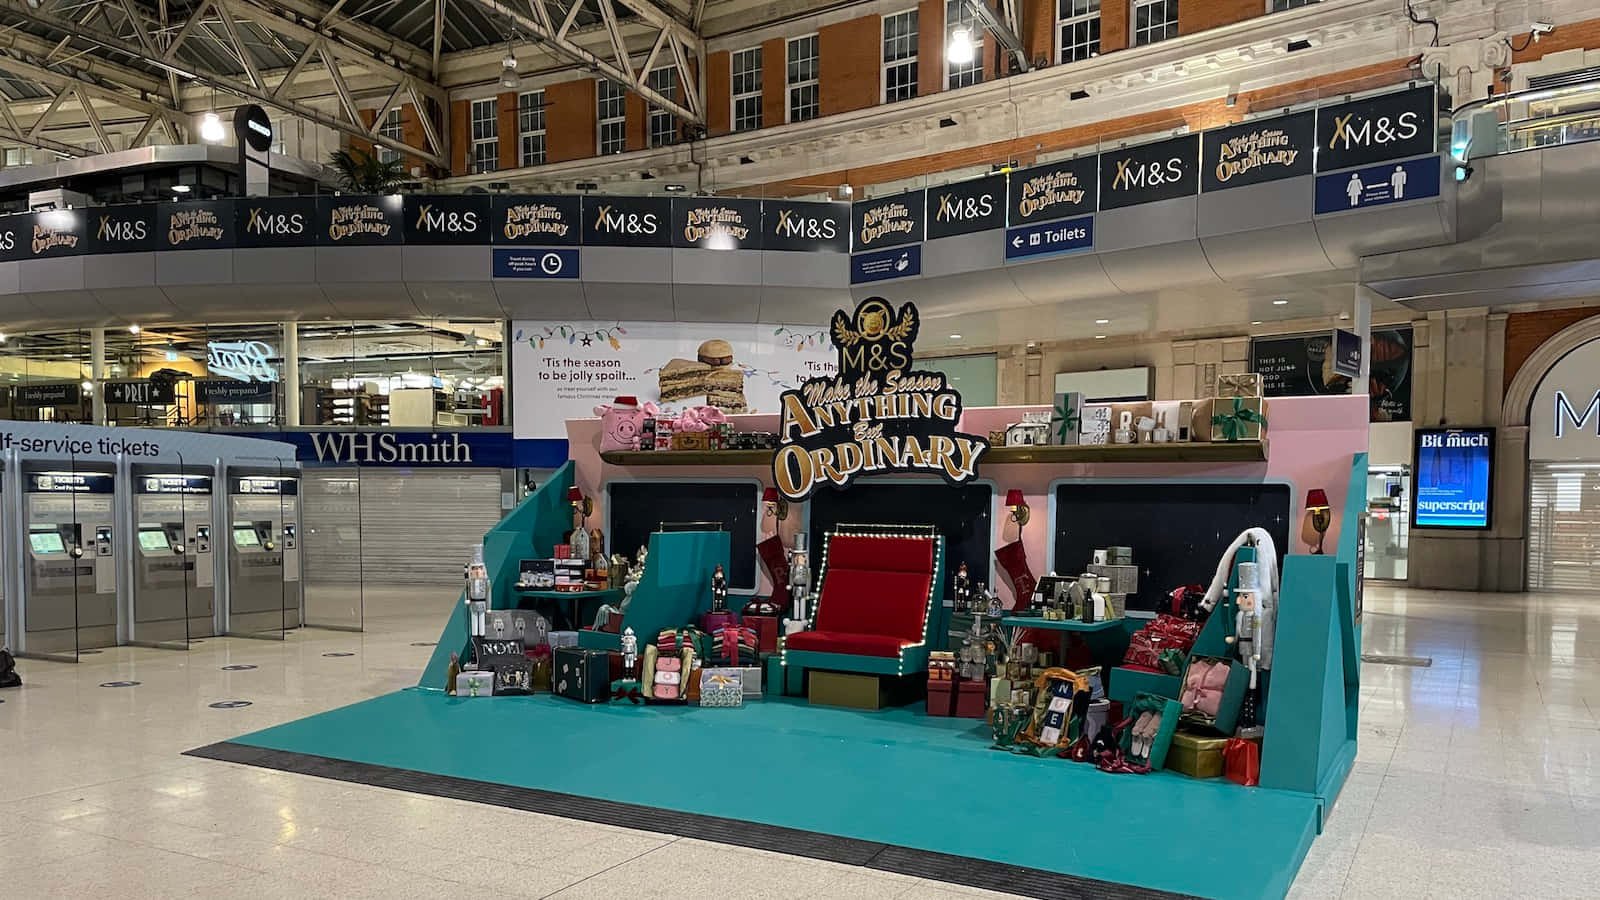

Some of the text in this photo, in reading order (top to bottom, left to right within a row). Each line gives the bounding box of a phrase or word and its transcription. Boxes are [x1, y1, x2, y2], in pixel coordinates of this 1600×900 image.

[1219, 135, 1288, 163] ANYTHING
[1216, 150, 1298, 181] ORDINARY
[1020, 190, 1085, 217] ORDINARY
[329, 222, 391, 240] ORDINARY
[504, 222, 568, 240] ORDINARY
[861, 219, 914, 244] ORDINARY
[1045, 227, 1086, 243] Toilets
[542, 358, 621, 368] 'Tis the season
[805, 360, 821, 371] 'Tis
[842, 341, 908, 374] M&S
[539, 372, 550, 381] to
[553, 371, 567, 381] be
[569, 370, 593, 383] jolly
[804, 370, 942, 407] Make the Season
[780, 392, 958, 444] ANYTHING
[853, 421, 884, 441] But
[1422, 433, 1488, 447] Bit much
[97, 437, 159, 456] tickets
[310, 433, 472, 463] WHSmith
[775, 435, 986, 498] ORDINARY
[1418, 499, 1485, 513] superscript
